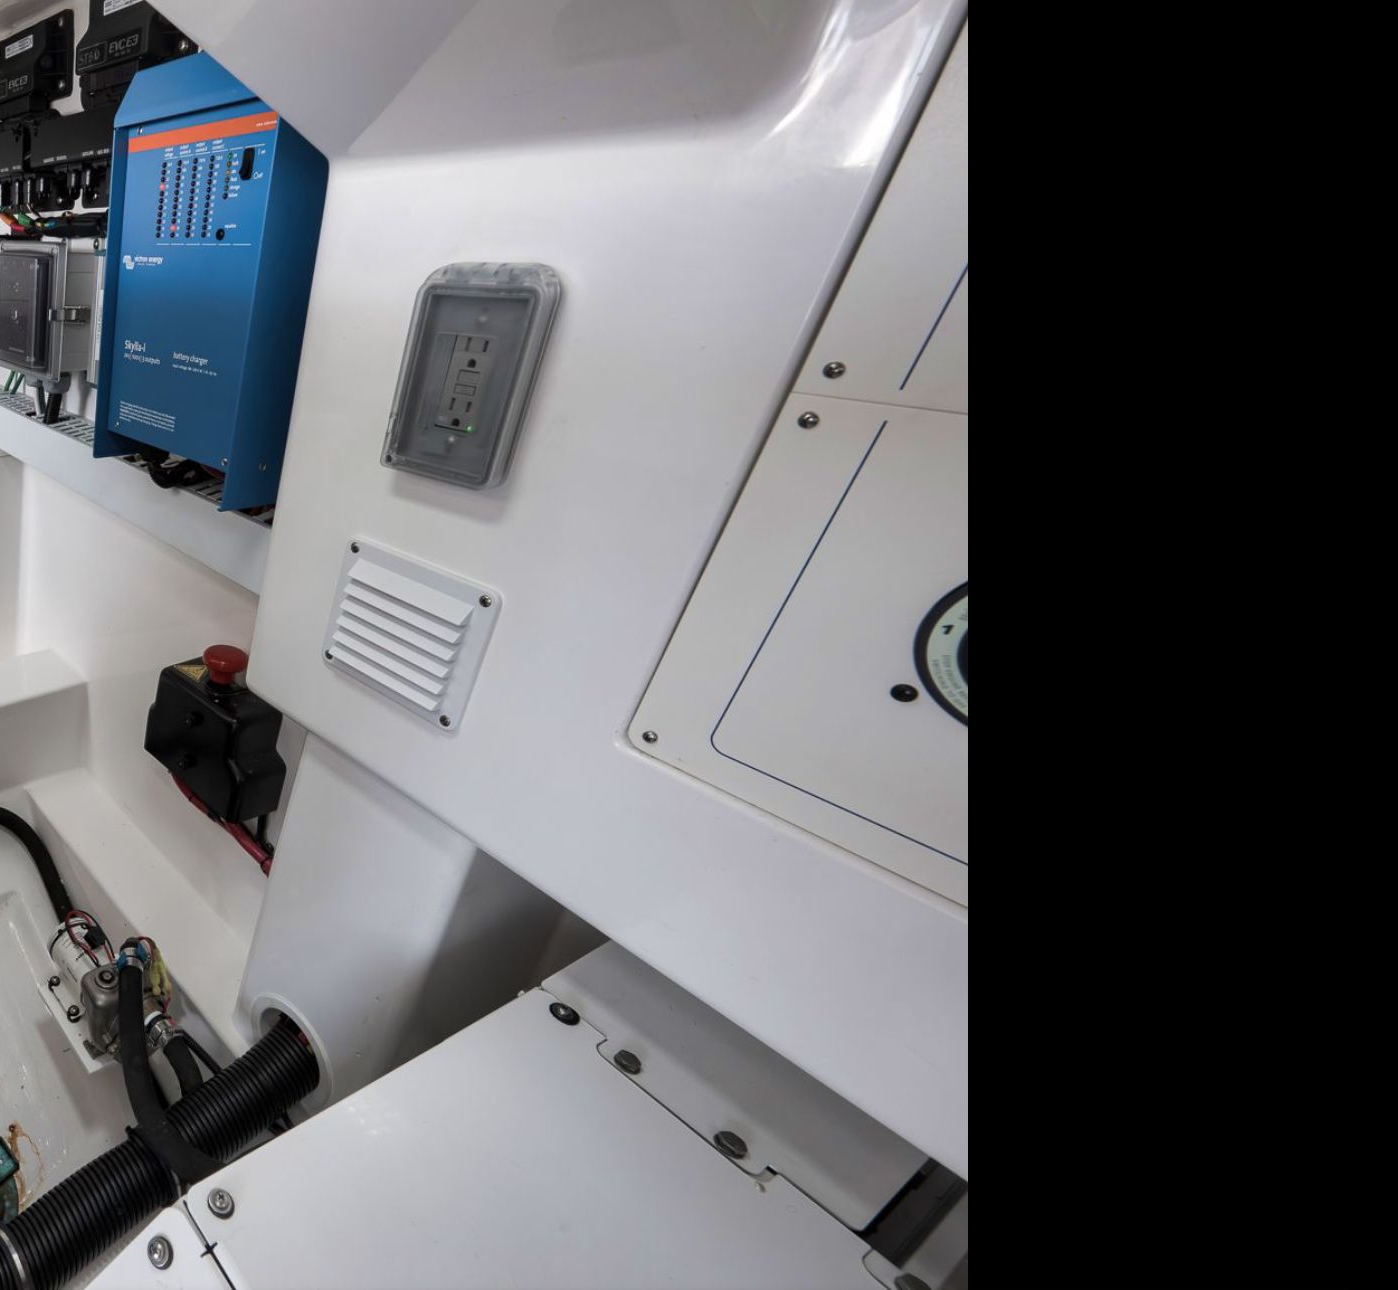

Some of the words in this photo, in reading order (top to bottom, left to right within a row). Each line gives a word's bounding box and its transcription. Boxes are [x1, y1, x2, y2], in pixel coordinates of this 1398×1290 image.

[149, 256, 163, 265] energy
[173, 352, 189, 363] battery
[190, 355, 208, 366] charger
